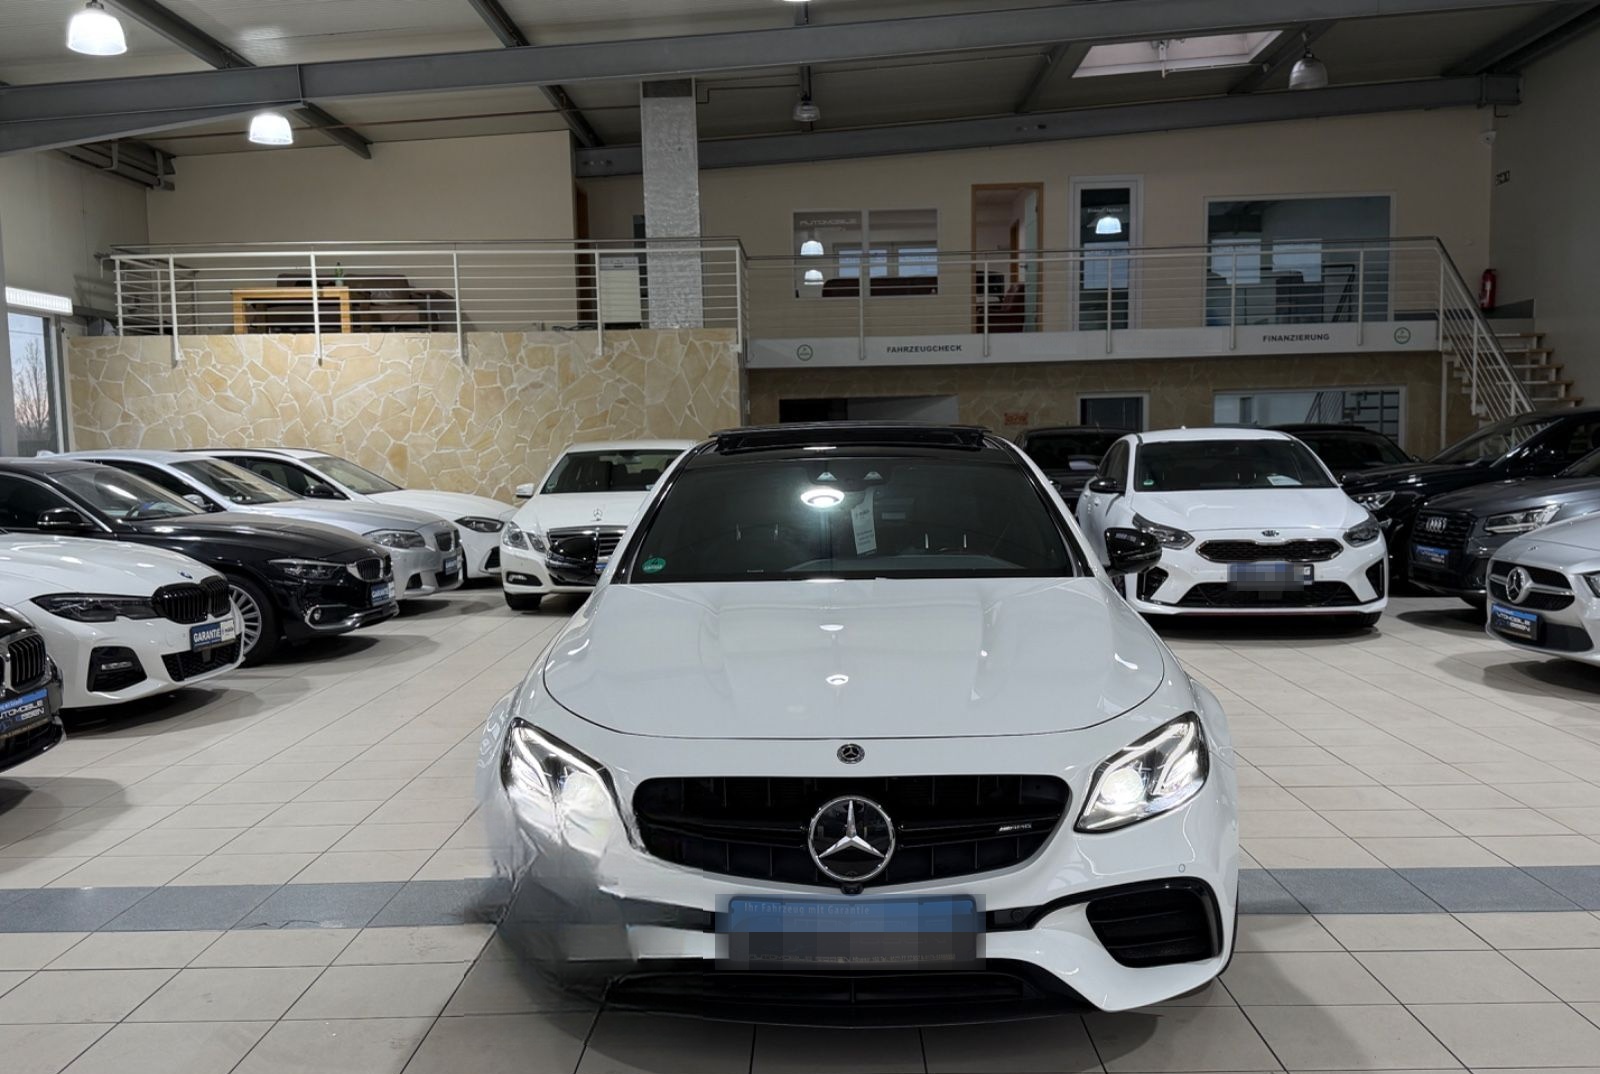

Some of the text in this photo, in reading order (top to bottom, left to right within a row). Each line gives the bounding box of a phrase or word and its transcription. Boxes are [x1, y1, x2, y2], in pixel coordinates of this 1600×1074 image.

[1262, 333, 1330, 343] FINANZIERUNG
[886, 344, 962, 354] FAHRZEUGCHECK
[193, 628, 222, 643] GARANTIE
[744, 902, 870, 916] Ihr Fahrzeug mit Garantie
